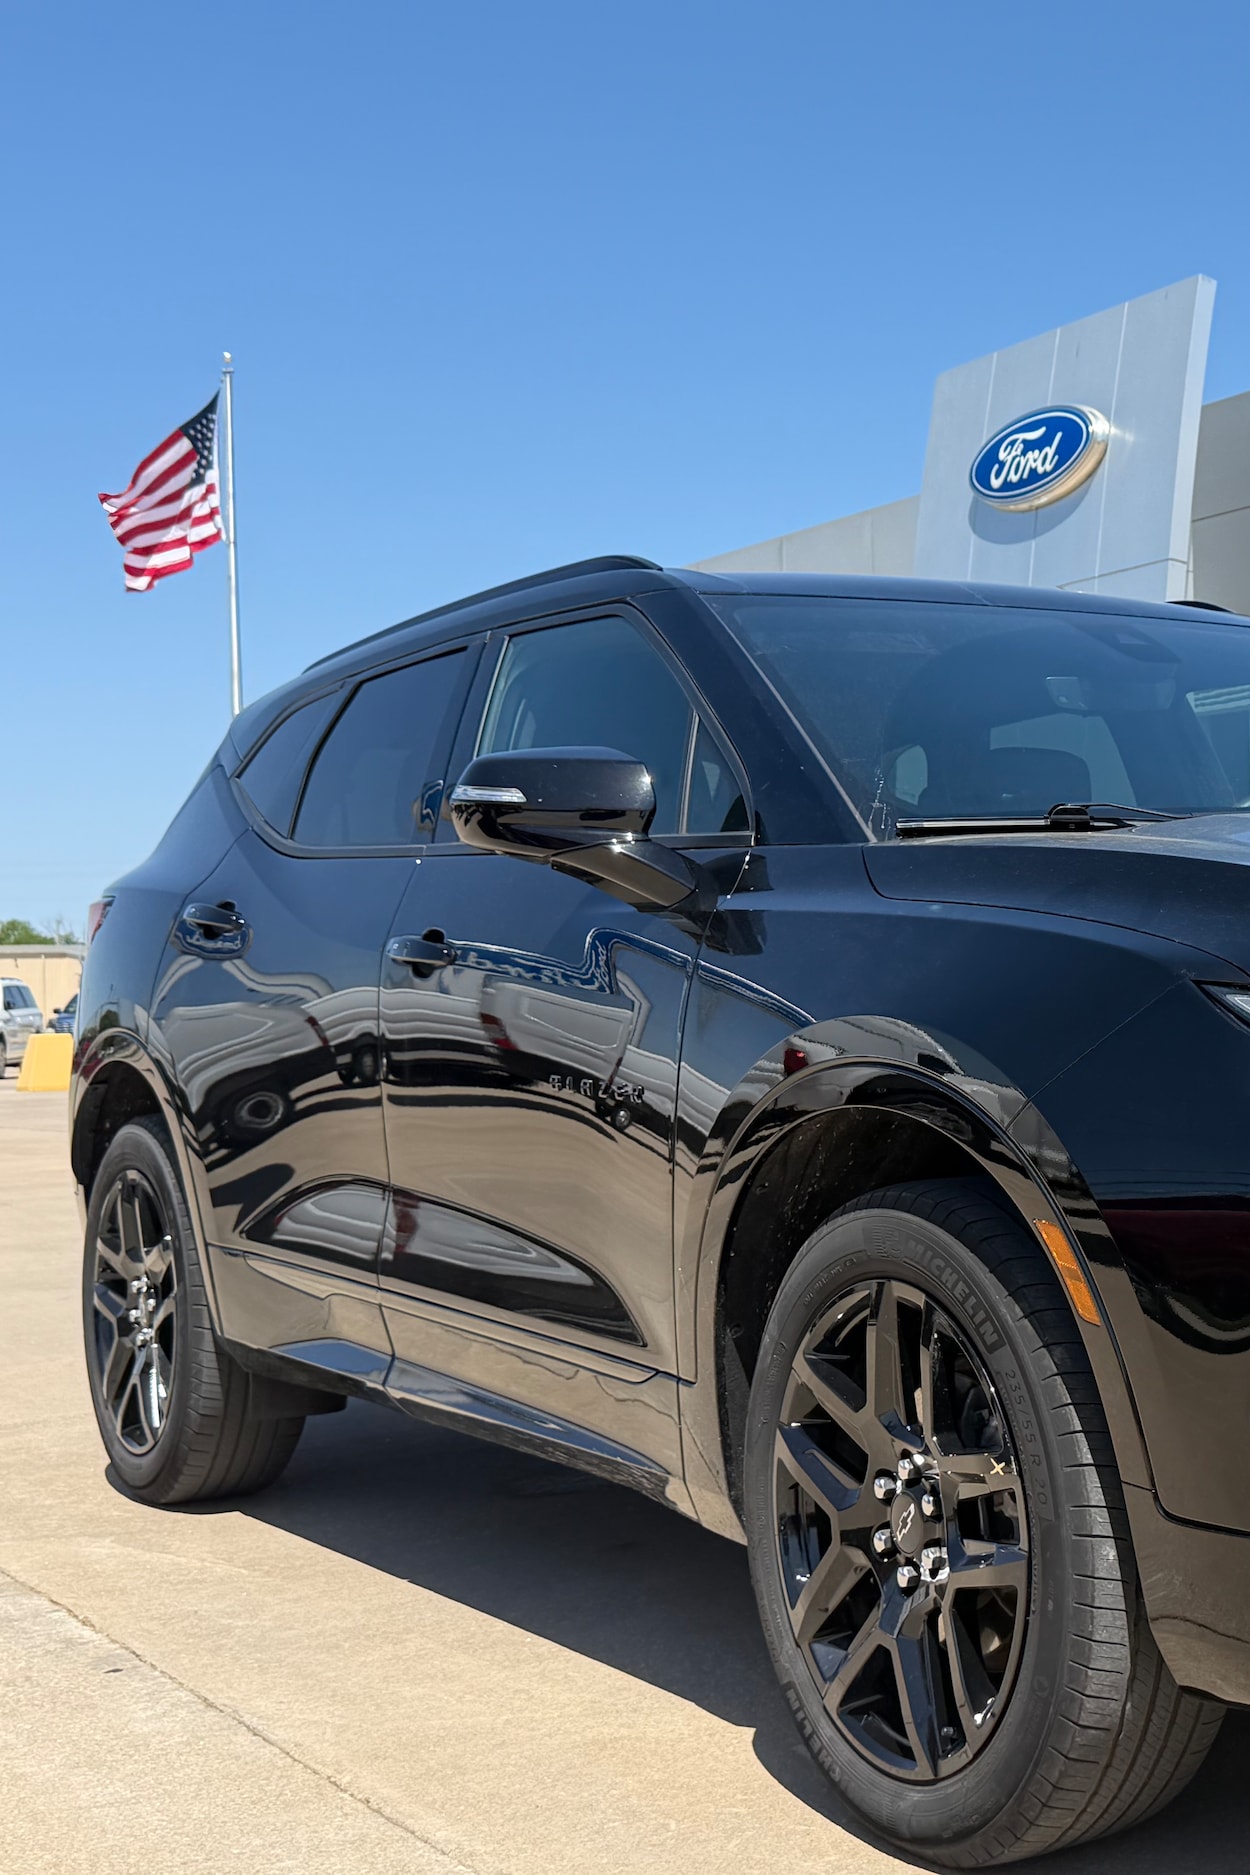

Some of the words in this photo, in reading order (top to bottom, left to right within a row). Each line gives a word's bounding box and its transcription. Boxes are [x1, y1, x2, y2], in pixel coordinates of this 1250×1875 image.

[990, 426, 1063, 490] Ford
[906, 1240, 999, 1348] MICHELIN
[1005, 1369, 1037, 1444] 235/55
[1029, 1453, 1042, 1467] R
[785, 1687, 843, 1784] CHELIN
